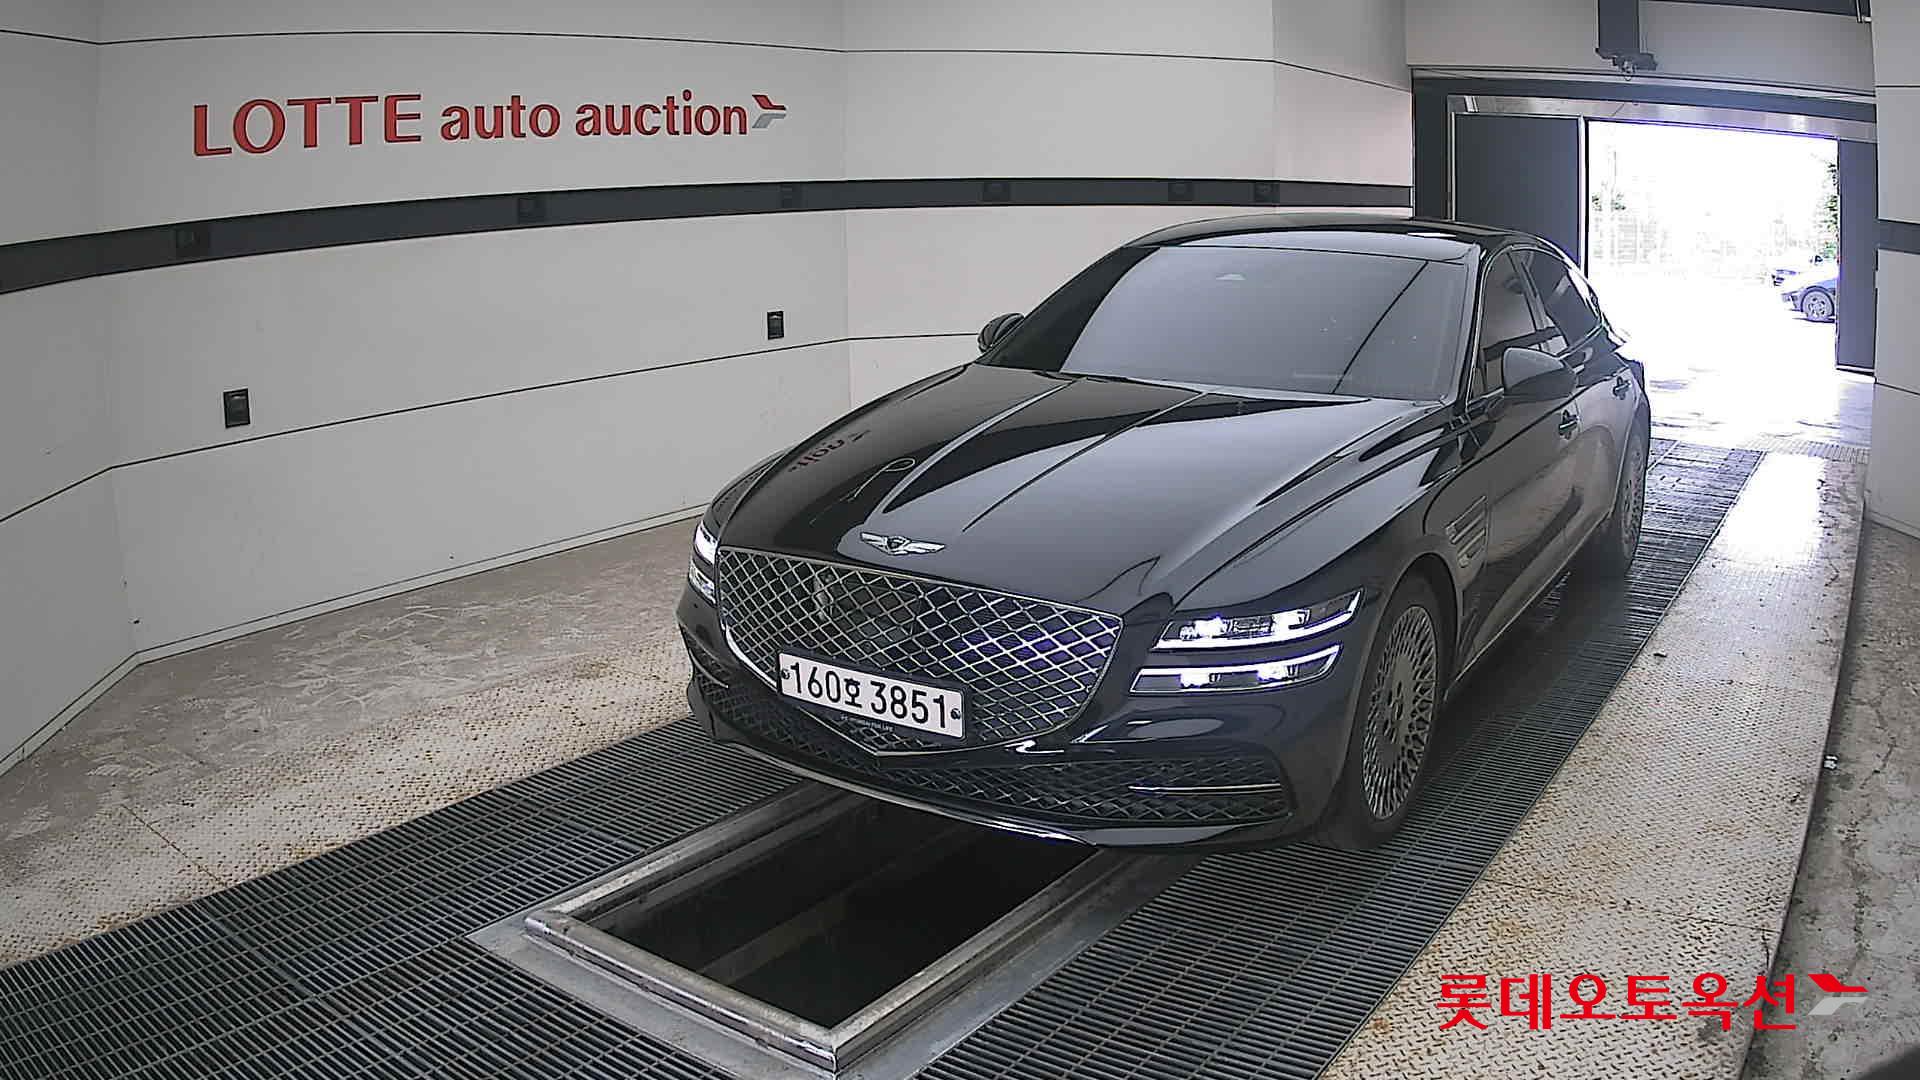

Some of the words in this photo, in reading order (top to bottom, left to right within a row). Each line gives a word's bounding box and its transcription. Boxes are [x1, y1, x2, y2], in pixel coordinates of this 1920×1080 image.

[193, 93, 422, 157] LOTTE
[440, 94, 561, 140] auto
[575, 88, 748, 136] auction
[790, 661, 863, 709] 160호
[870, 680, 947, 729] 3851
